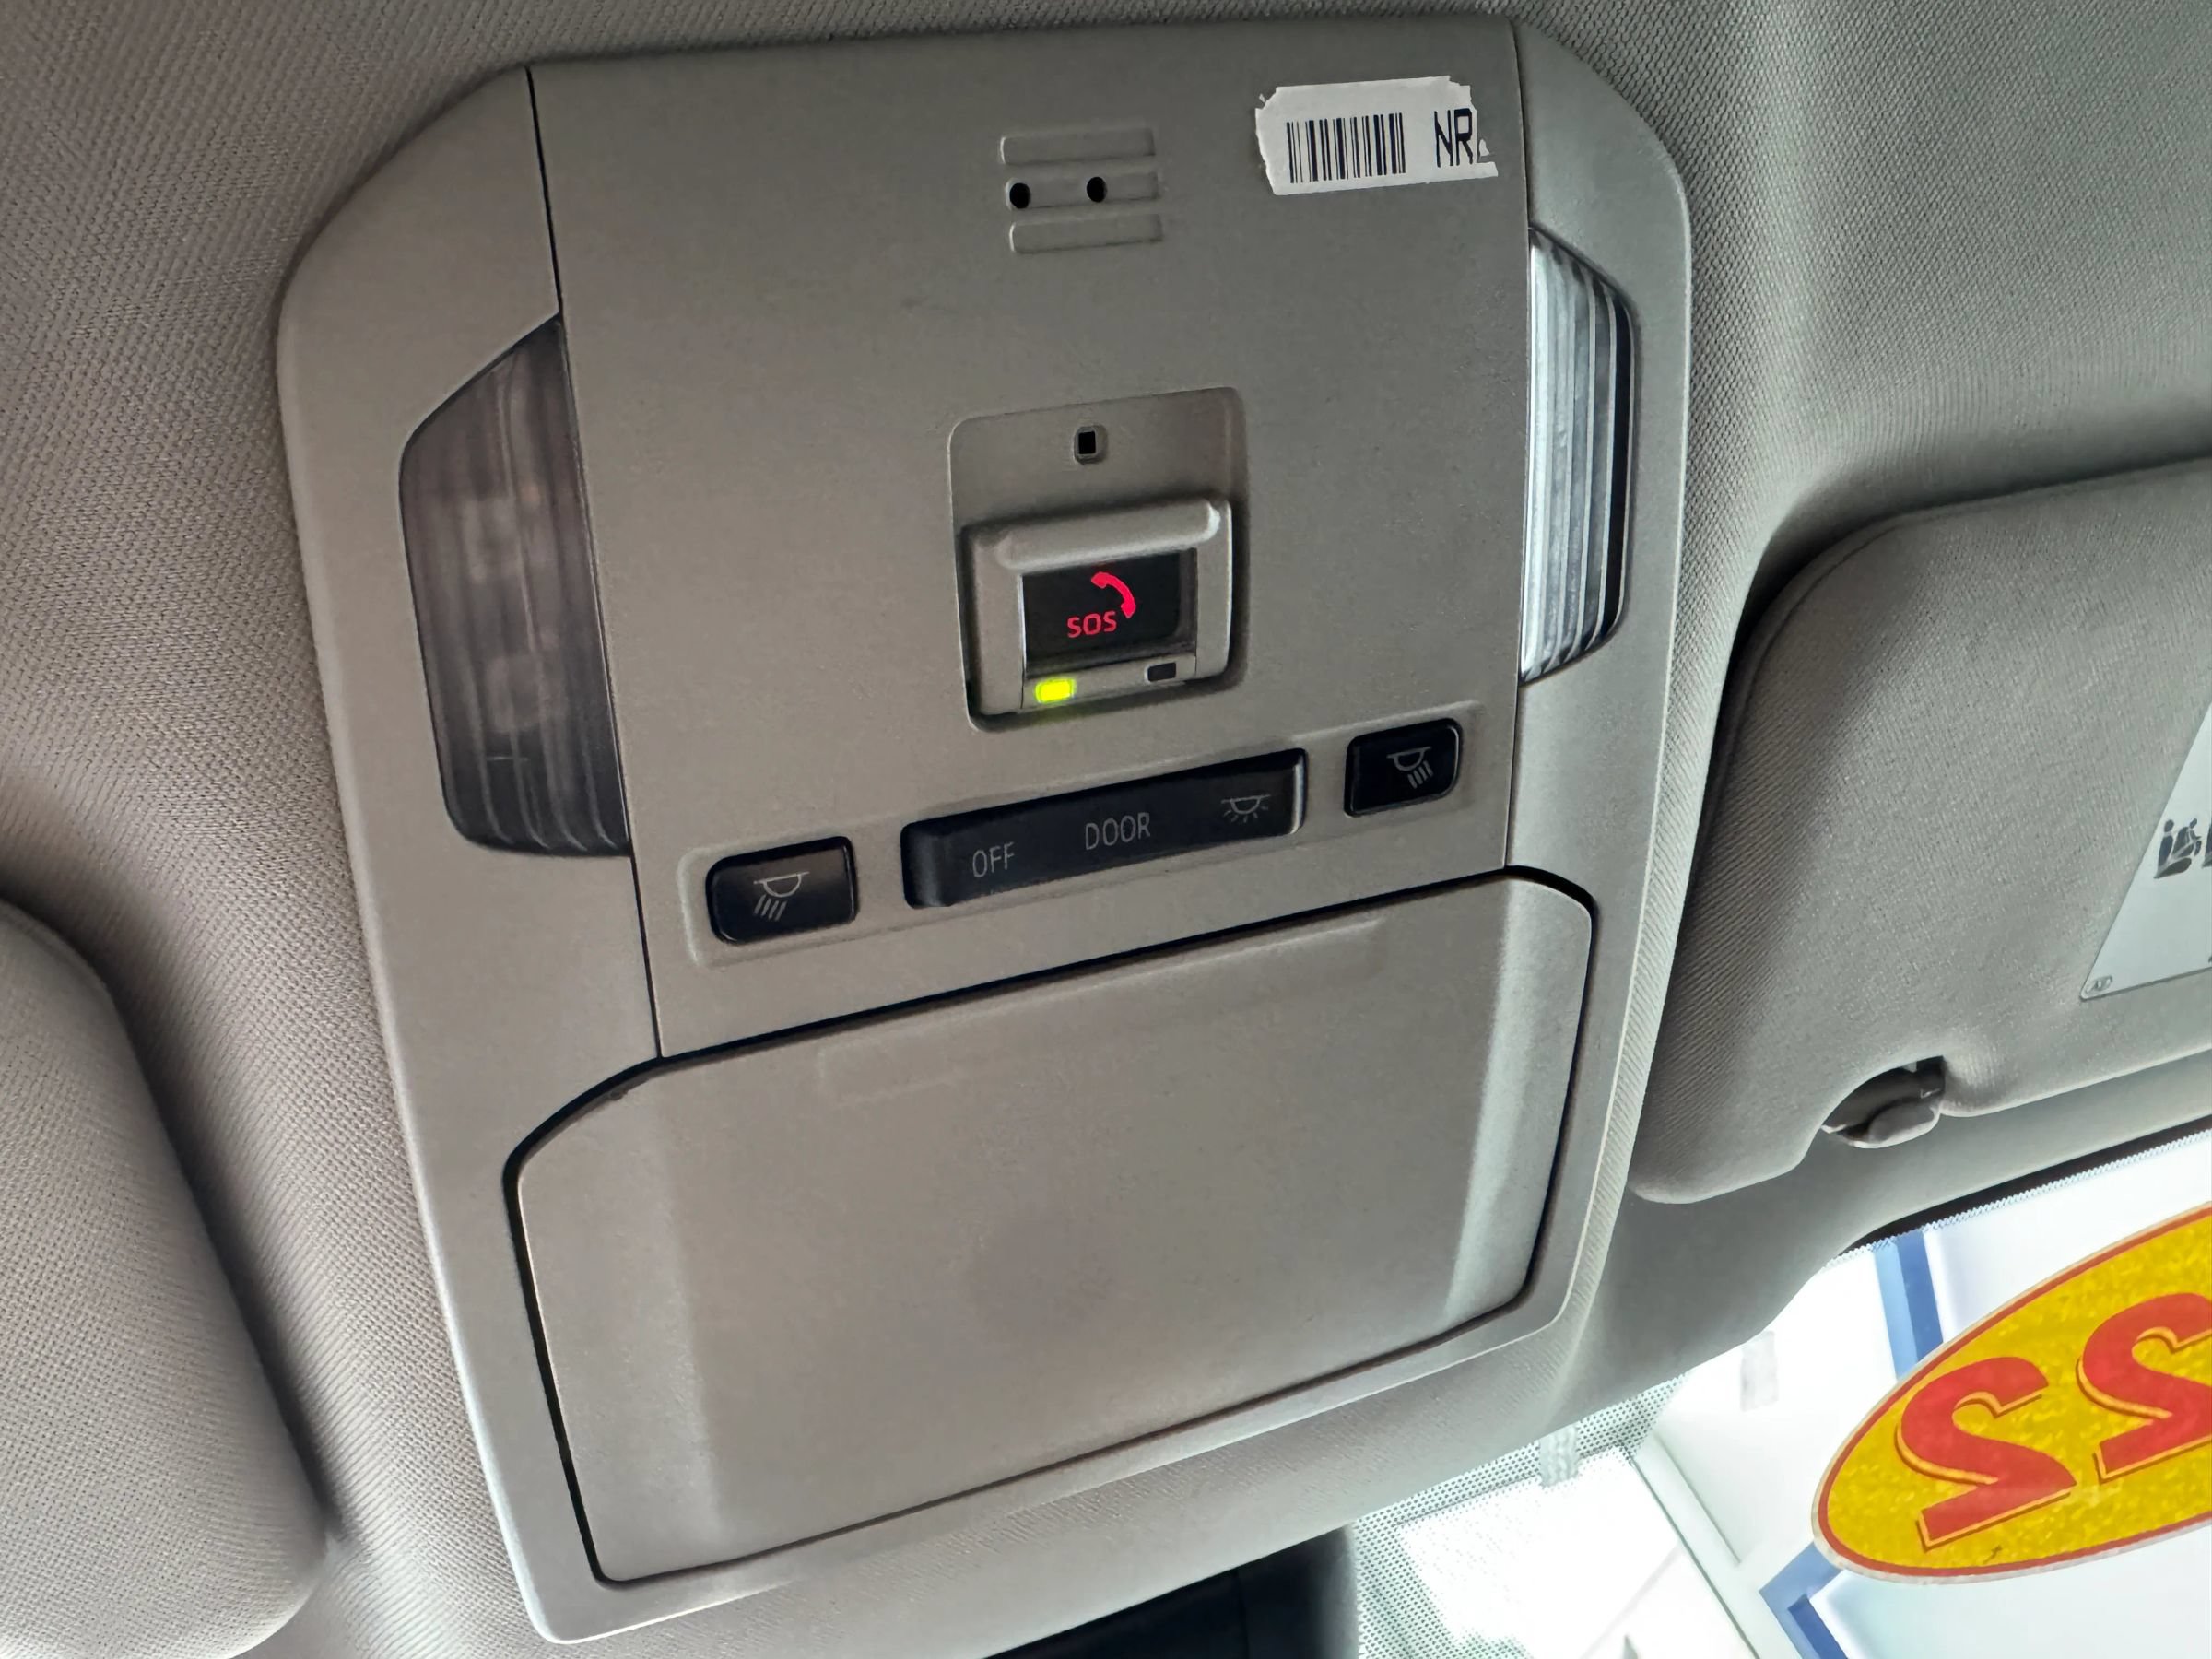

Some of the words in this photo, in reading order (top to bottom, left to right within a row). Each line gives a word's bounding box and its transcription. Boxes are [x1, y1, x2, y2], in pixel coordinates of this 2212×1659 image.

[1434, 108, 1474, 168] NR
[1066, 610, 1117, 638] SOS
[1085, 812, 1151, 852] DOOR
[972, 841, 1015, 878] OFF
